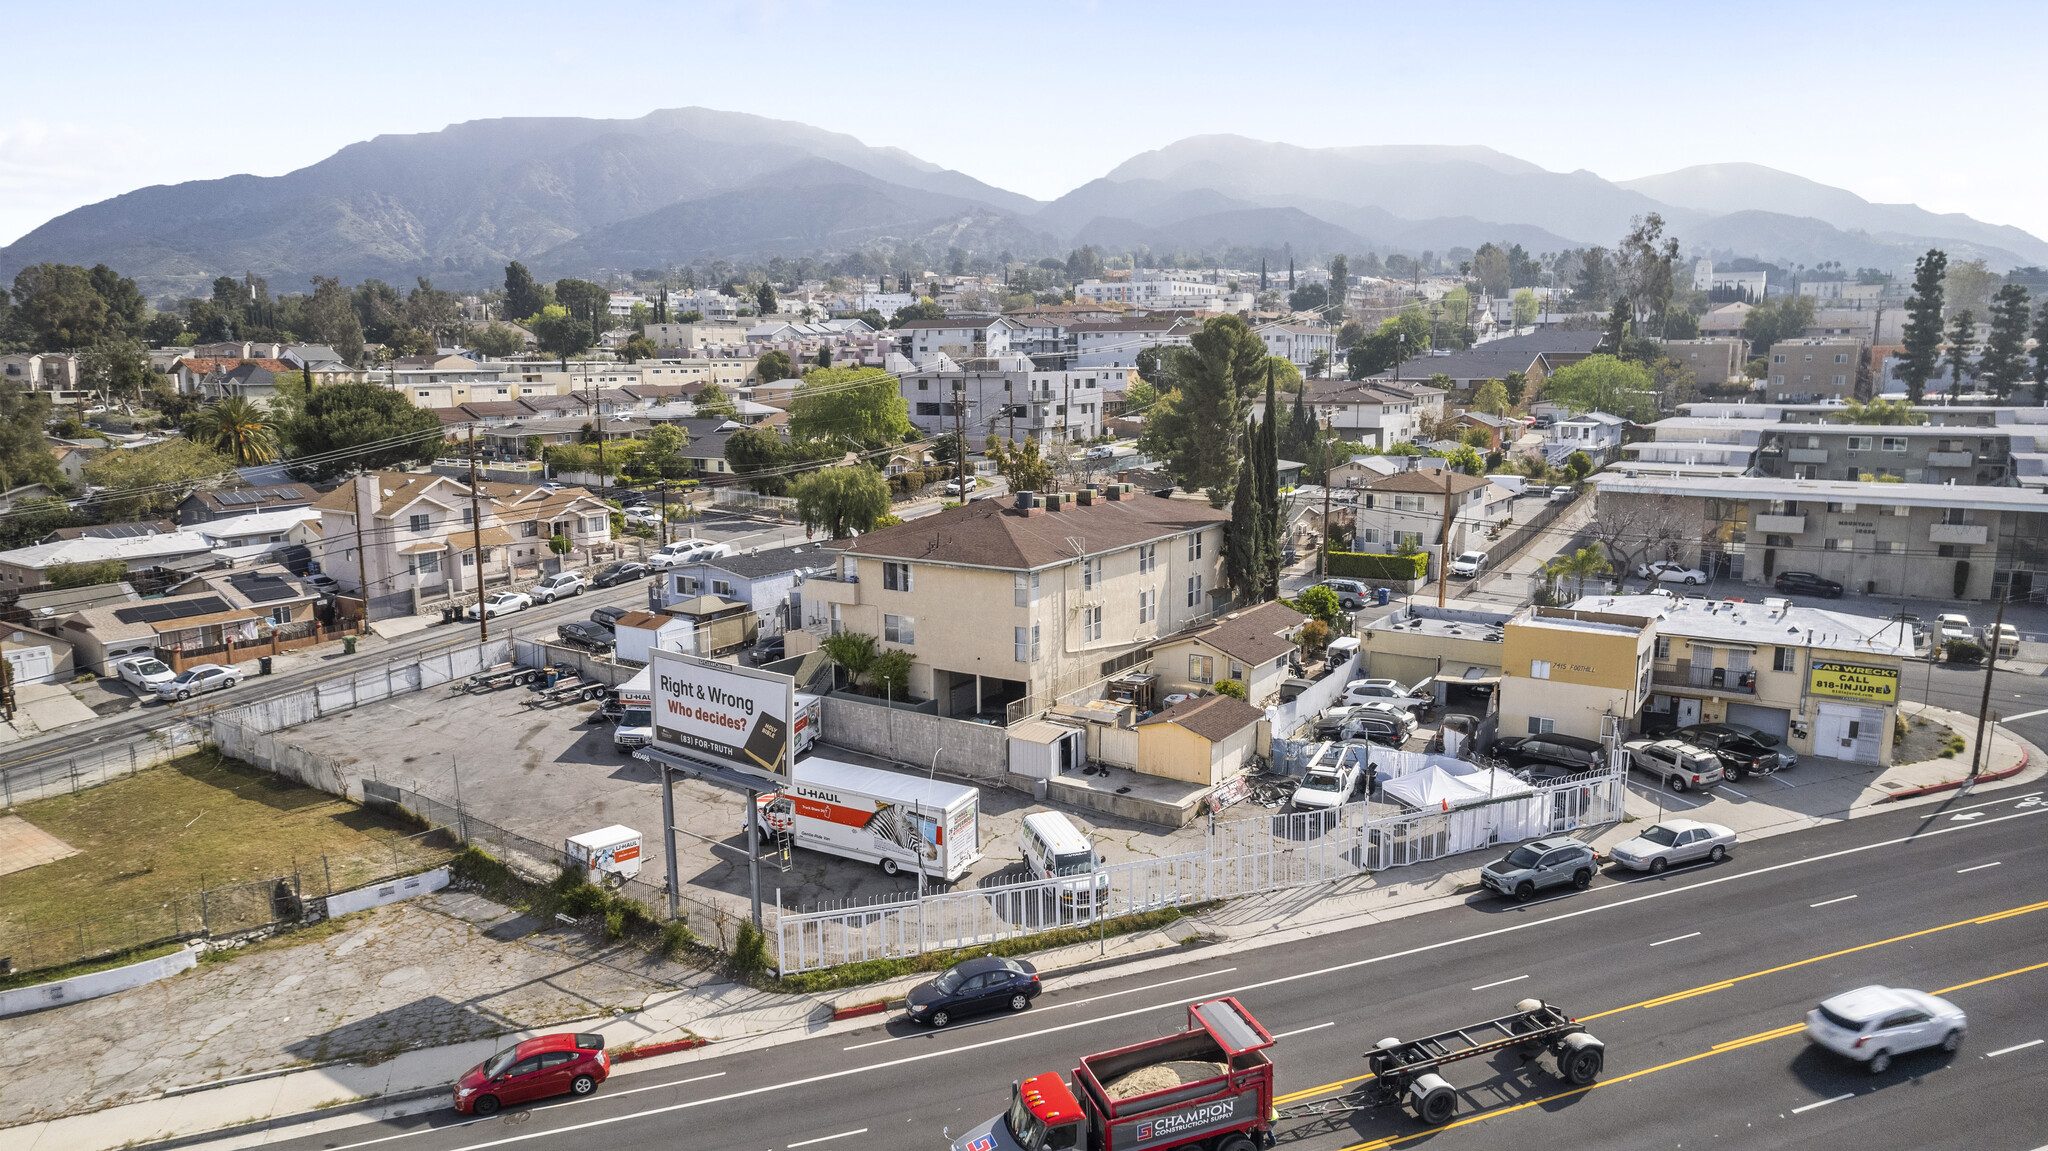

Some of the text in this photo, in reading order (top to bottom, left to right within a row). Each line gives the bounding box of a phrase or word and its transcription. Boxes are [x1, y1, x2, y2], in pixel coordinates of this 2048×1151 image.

[1570, 665, 1595, 673] FOOTHILL
[1843, 666, 1897, 677] WRECK?
[1839, 675, 1870, 684] CALL
[661, 675, 754, 716] Right & Wrong
[668, 699, 748, 732] Who decides?
[761, 728, 776, 739] BIBLE
[764, 723, 778, 733] HOLY
[680, 734, 694, 746] (83)
[694, 738, 733, 756] FOR-TRUTH
[797, 787, 841, 803] U-HAUL
[1154, 1101, 1234, 1130] CHAMPION
[1155, 1112, 1232, 1137] CONSTRUCTION SUPPLY
